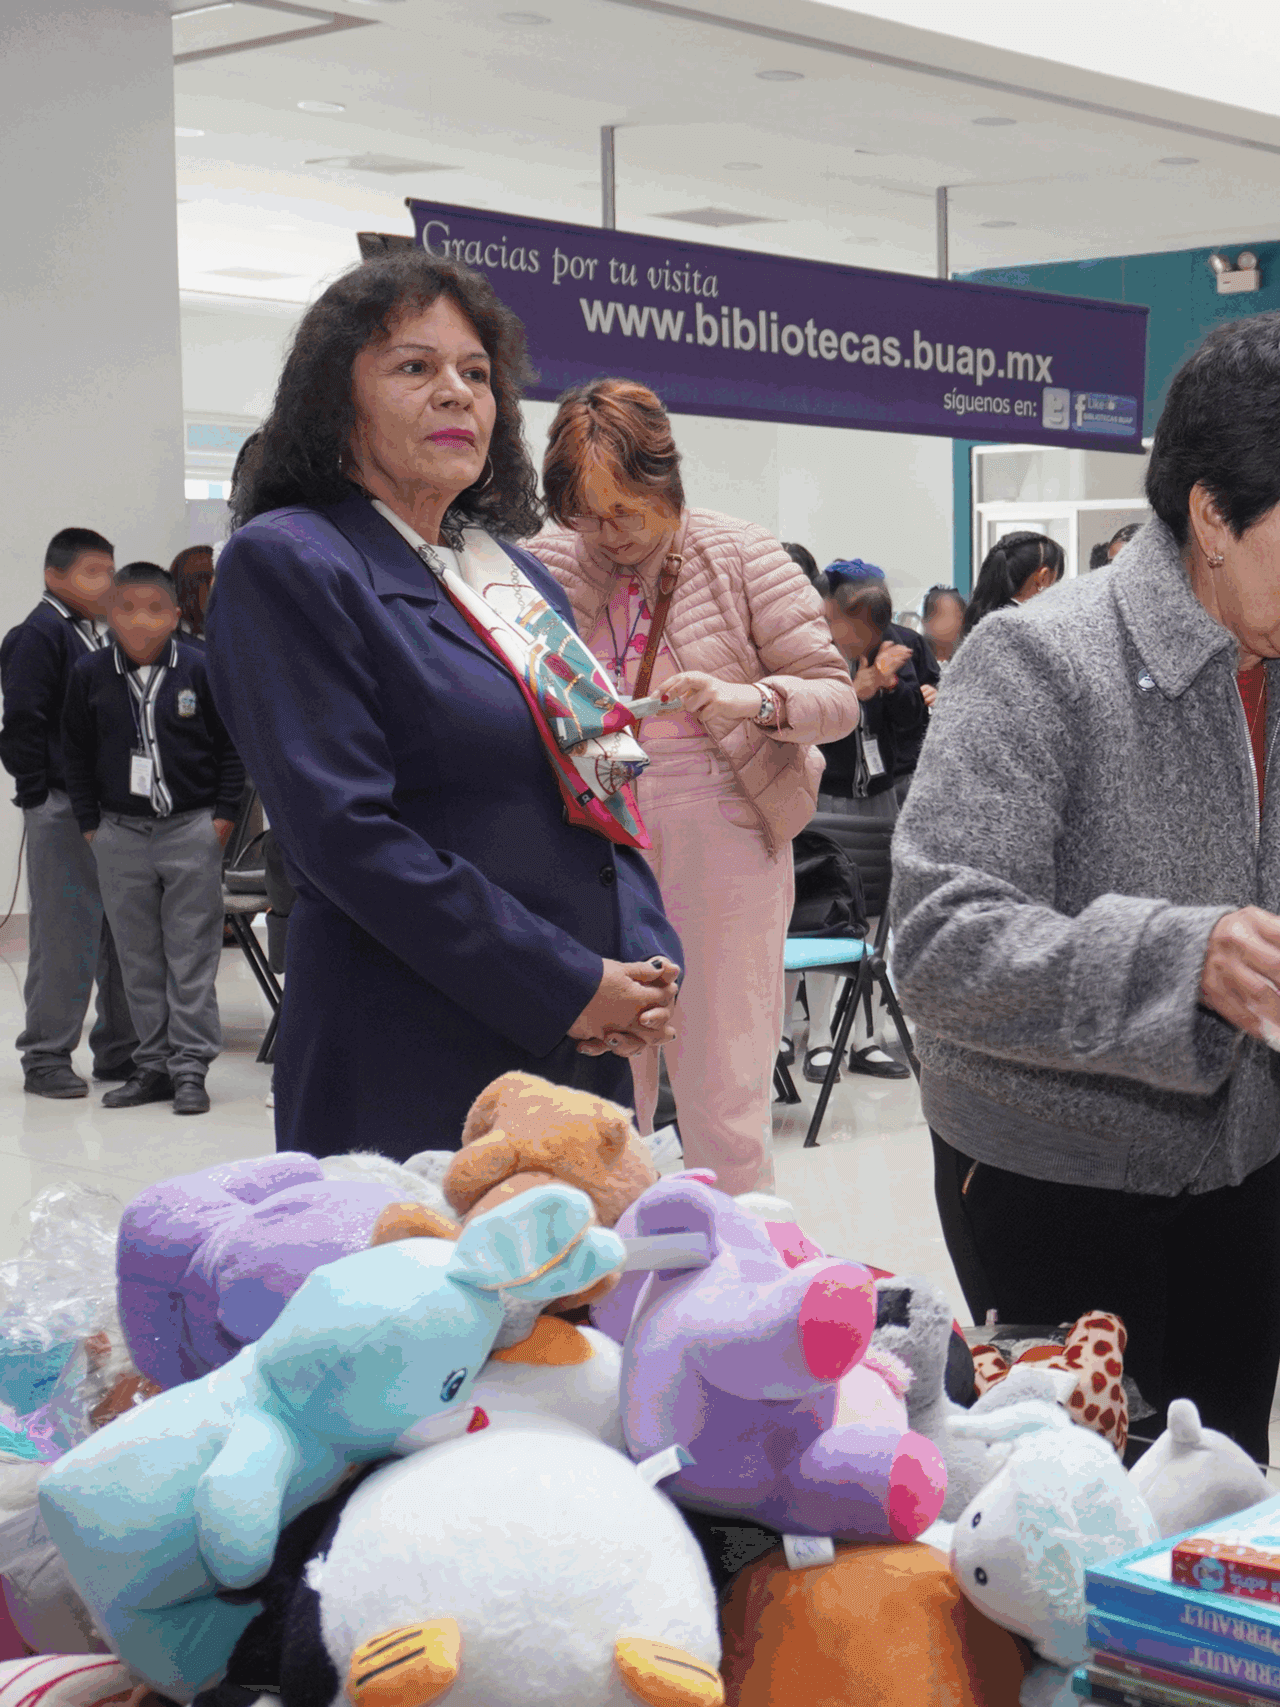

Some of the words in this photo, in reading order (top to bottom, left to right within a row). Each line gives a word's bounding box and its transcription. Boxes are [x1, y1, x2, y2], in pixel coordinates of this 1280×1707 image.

[421, 220, 540, 274] Gracias
[552, 247, 600, 285] por
[608, 257, 639, 287] tu
[646, 260, 720, 298] visita
[579, 298, 1054, 386] www.bibliotecas.buap.mx
[943, 387, 1011, 416] síguenos
[1014, 399, 1038, 417] en:
